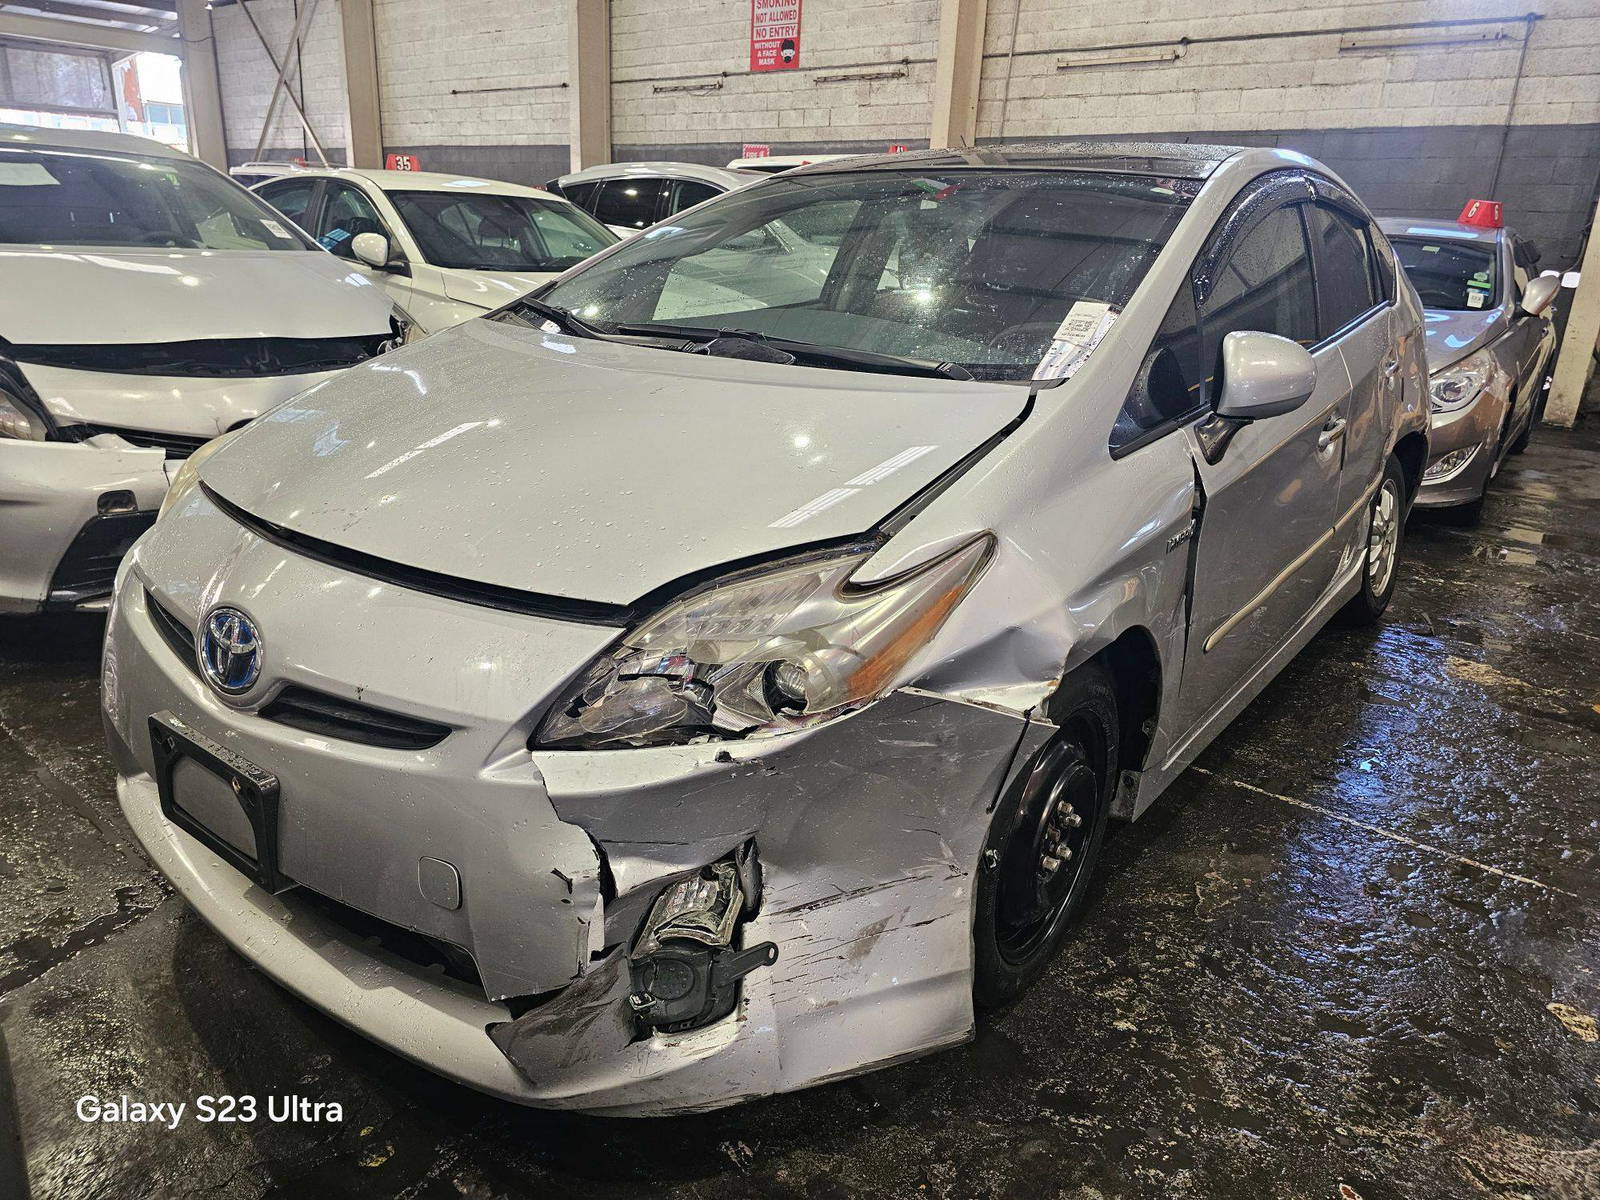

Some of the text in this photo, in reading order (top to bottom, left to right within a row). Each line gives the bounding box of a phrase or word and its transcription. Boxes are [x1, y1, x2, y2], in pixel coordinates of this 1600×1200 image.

[756, 10, 797, 23] NOT ALLOWED
[756, 25, 796, 38] NO ENTRY
[754, 41, 780, 49] WITHOUT
[761, 49, 777, 57] FACE
[396, 155, 411, 171] 35
[1468, 201, 1480, 218] 6
